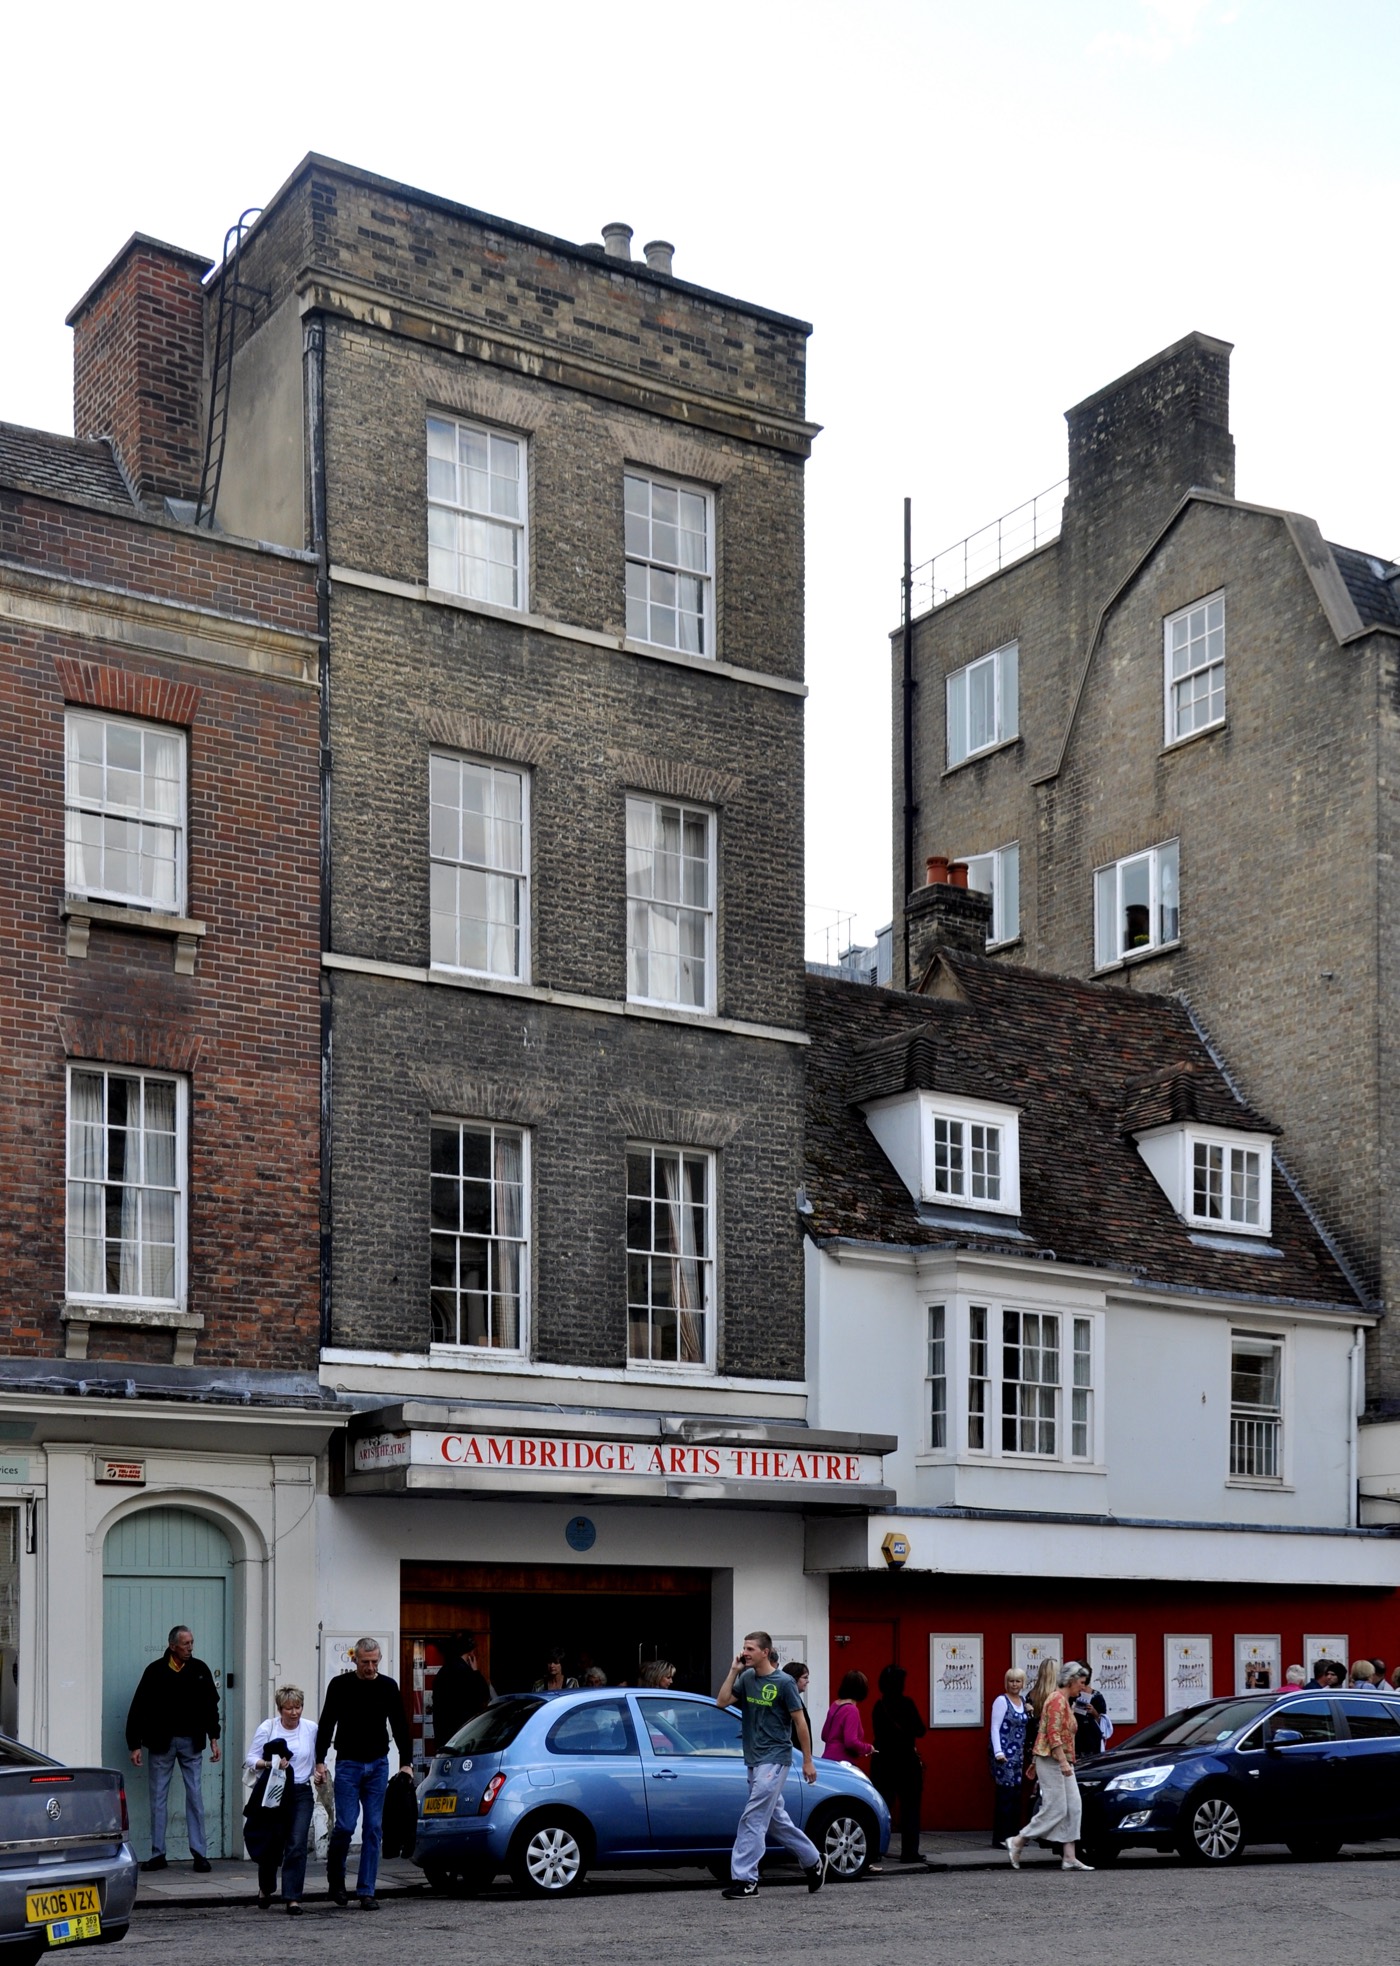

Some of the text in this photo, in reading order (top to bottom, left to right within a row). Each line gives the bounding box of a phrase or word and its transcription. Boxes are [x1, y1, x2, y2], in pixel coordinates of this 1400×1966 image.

[440, 1435, 861, 1481] CAMBRIDGE ARTS THEATRE
[0, 1466, 18, 1475] ices
[31, 1890, 95, 1918] YK06 VZX
[85, 1915, 98, 1925] 369
